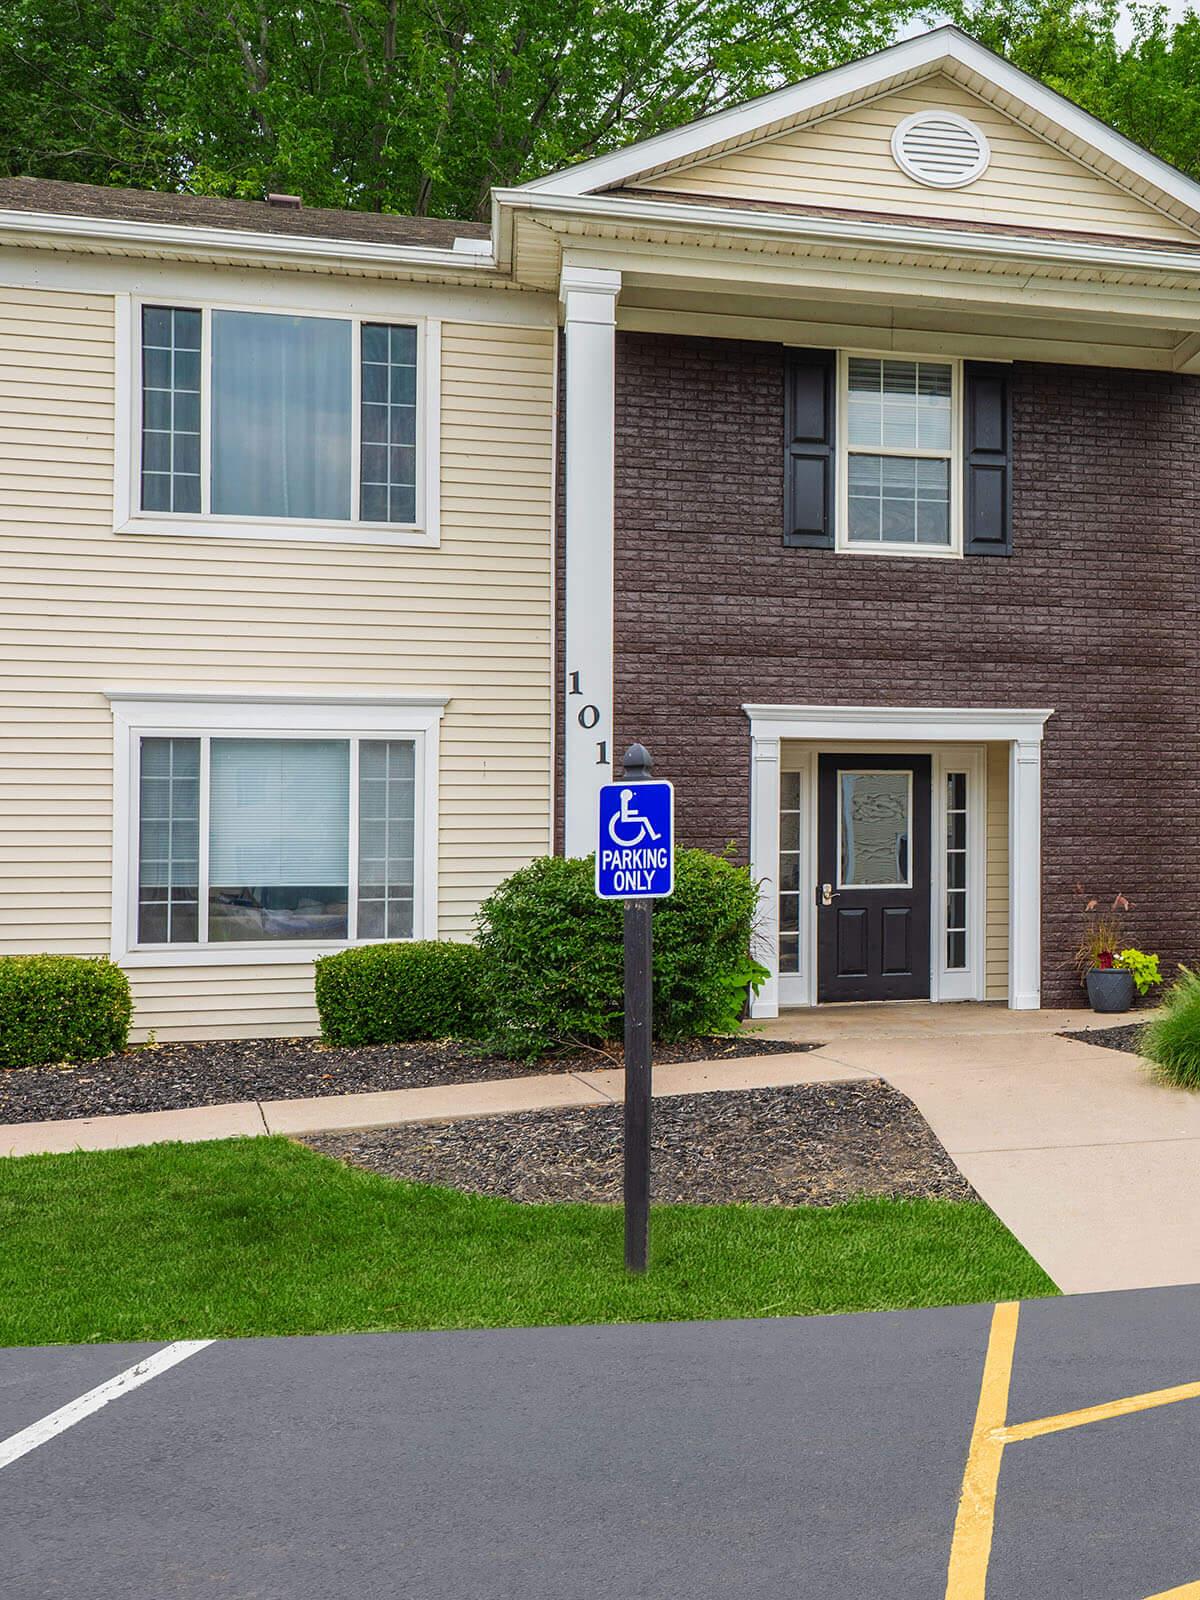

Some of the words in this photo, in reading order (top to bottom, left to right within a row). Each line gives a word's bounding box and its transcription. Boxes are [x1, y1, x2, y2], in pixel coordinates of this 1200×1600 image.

[568, 670, 610, 765] 101
[602, 848, 667, 870] PARKING
[613, 870, 656, 892] ONLY
